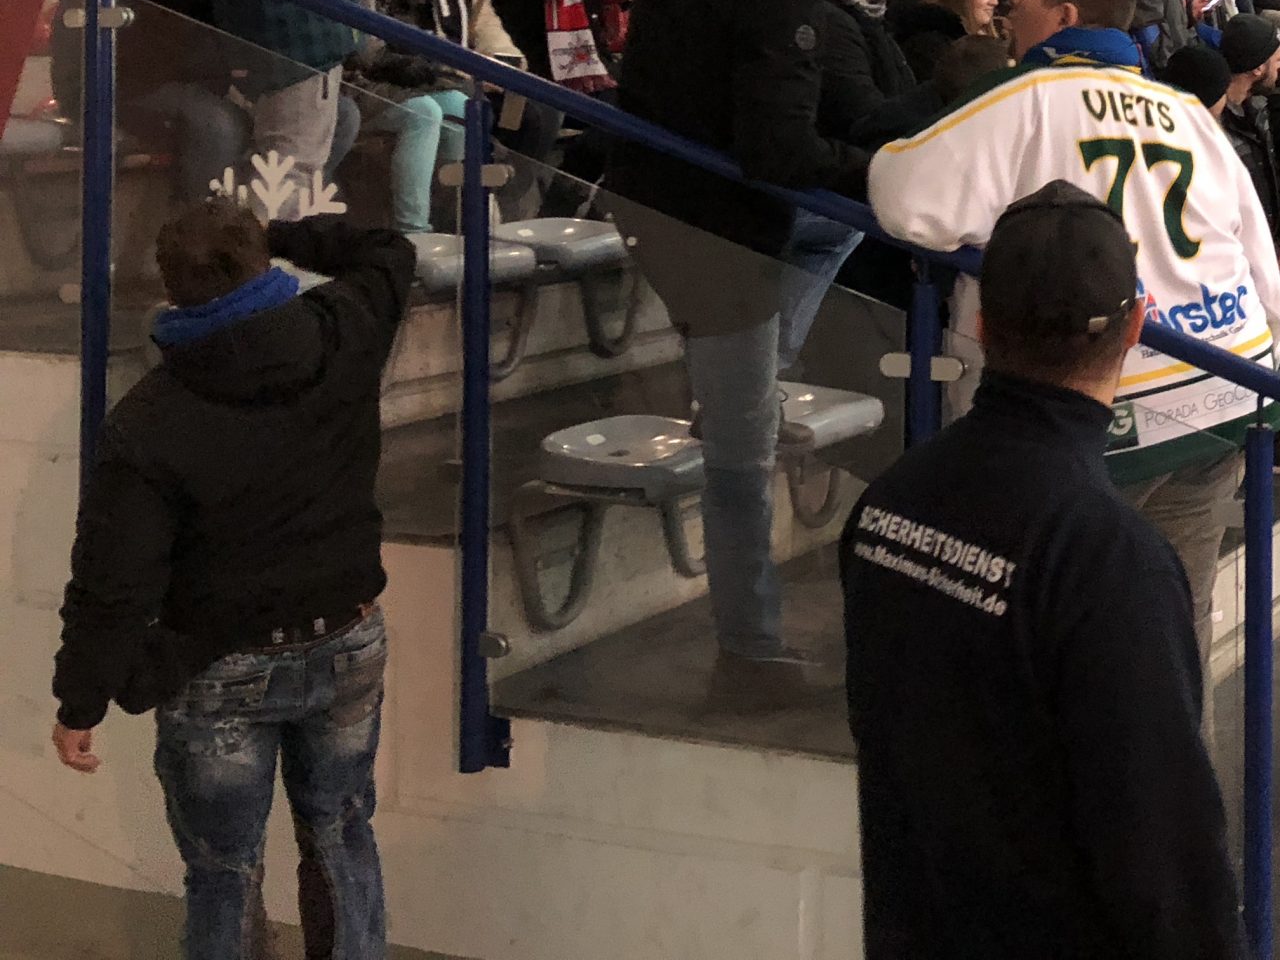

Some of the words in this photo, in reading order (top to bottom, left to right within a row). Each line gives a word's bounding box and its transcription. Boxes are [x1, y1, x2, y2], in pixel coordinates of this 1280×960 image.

[1082, 89, 1175, 133] VIETS
[1078, 137, 1202, 260] 77
[1144, 402, 1199, 428] PORADA
